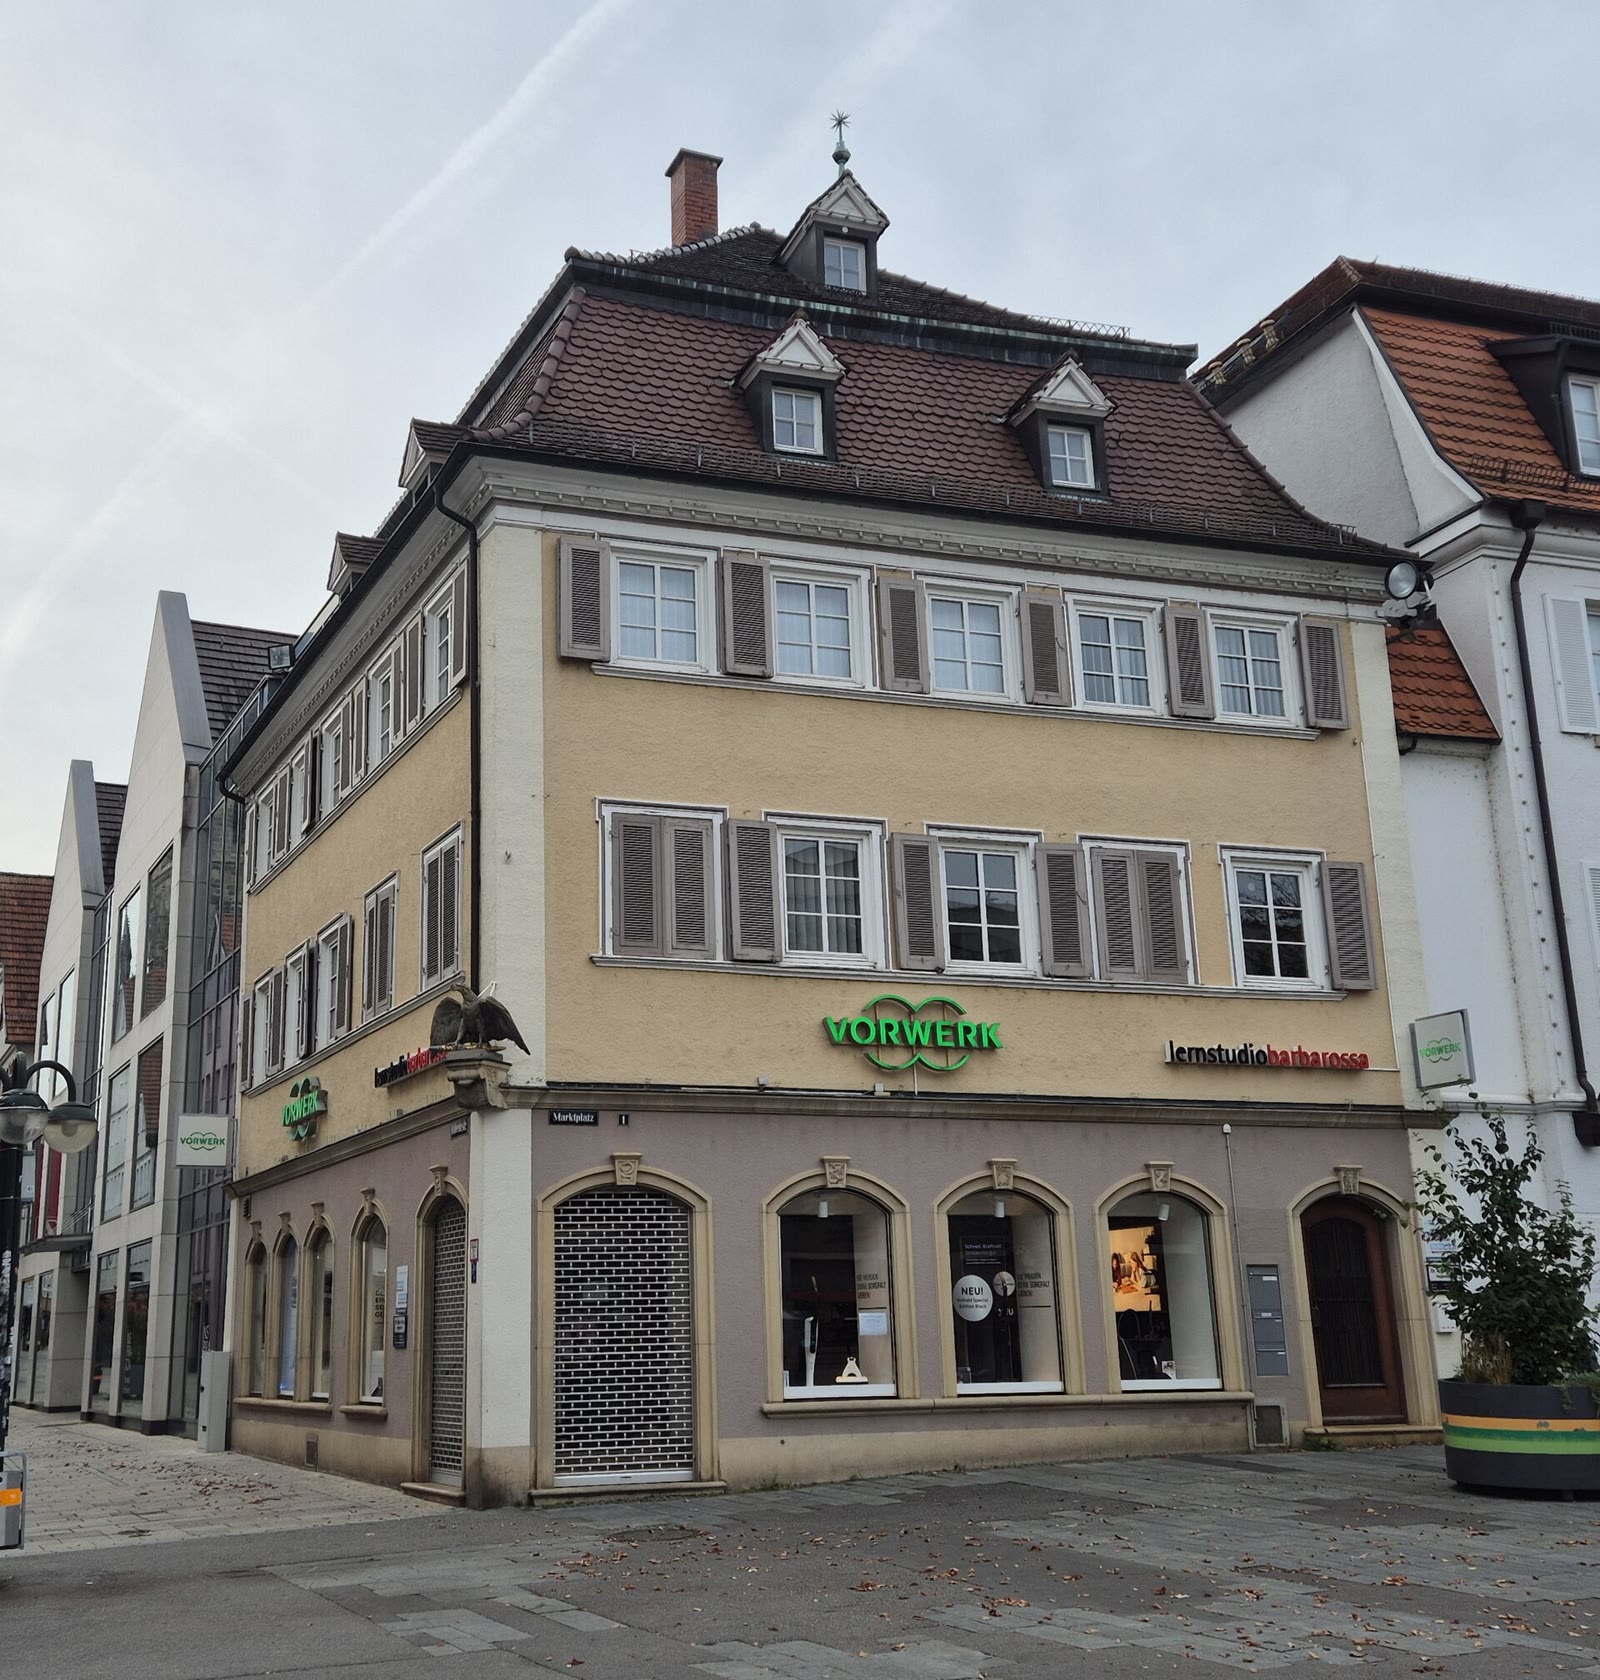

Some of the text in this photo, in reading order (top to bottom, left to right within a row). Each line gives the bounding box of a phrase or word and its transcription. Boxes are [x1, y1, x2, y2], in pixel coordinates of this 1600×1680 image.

[824, 1016, 1003, 1049] VORWERK
[1168, 1040, 1369, 1069] lernstudiobarbarossa
[1420, 1042, 1462, 1058] VORWERK
[281, 1090, 318, 1126] VORWERK
[552, 1112, 595, 1123] Marktplatz
[180, 1137, 225, 1146] VORWERK
[961, 1286, 984, 1296] NEU!
